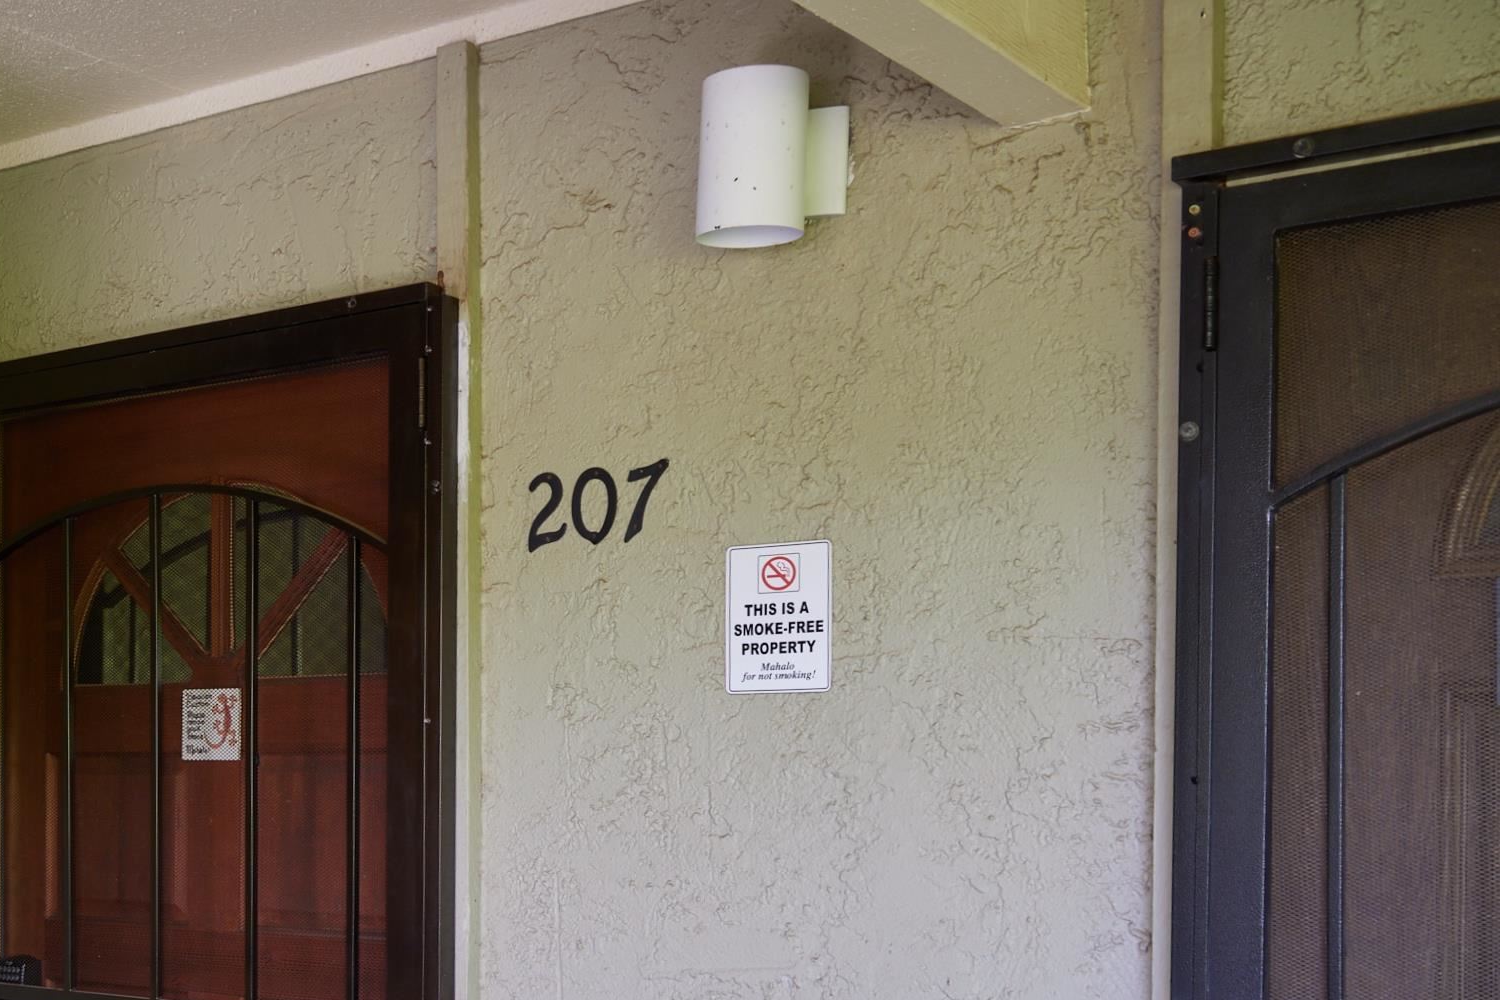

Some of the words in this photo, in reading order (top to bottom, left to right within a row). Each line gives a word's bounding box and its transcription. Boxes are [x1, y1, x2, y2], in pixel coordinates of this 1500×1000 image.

[527, 457, 670, 553] 207
[744, 603, 777, 617] THIS
[781, 602, 795, 615] IS
[799, 601, 809, 614] A
[734, 620, 824, 637] SMOKE-FREE
[741, 640, 816, 655] PROPERTY
[761, 661, 795, 671] Mahalo
[741, 671, 756, 683] for
[758, 671, 772, 680] not
[774, 670, 816, 680] smoking!
